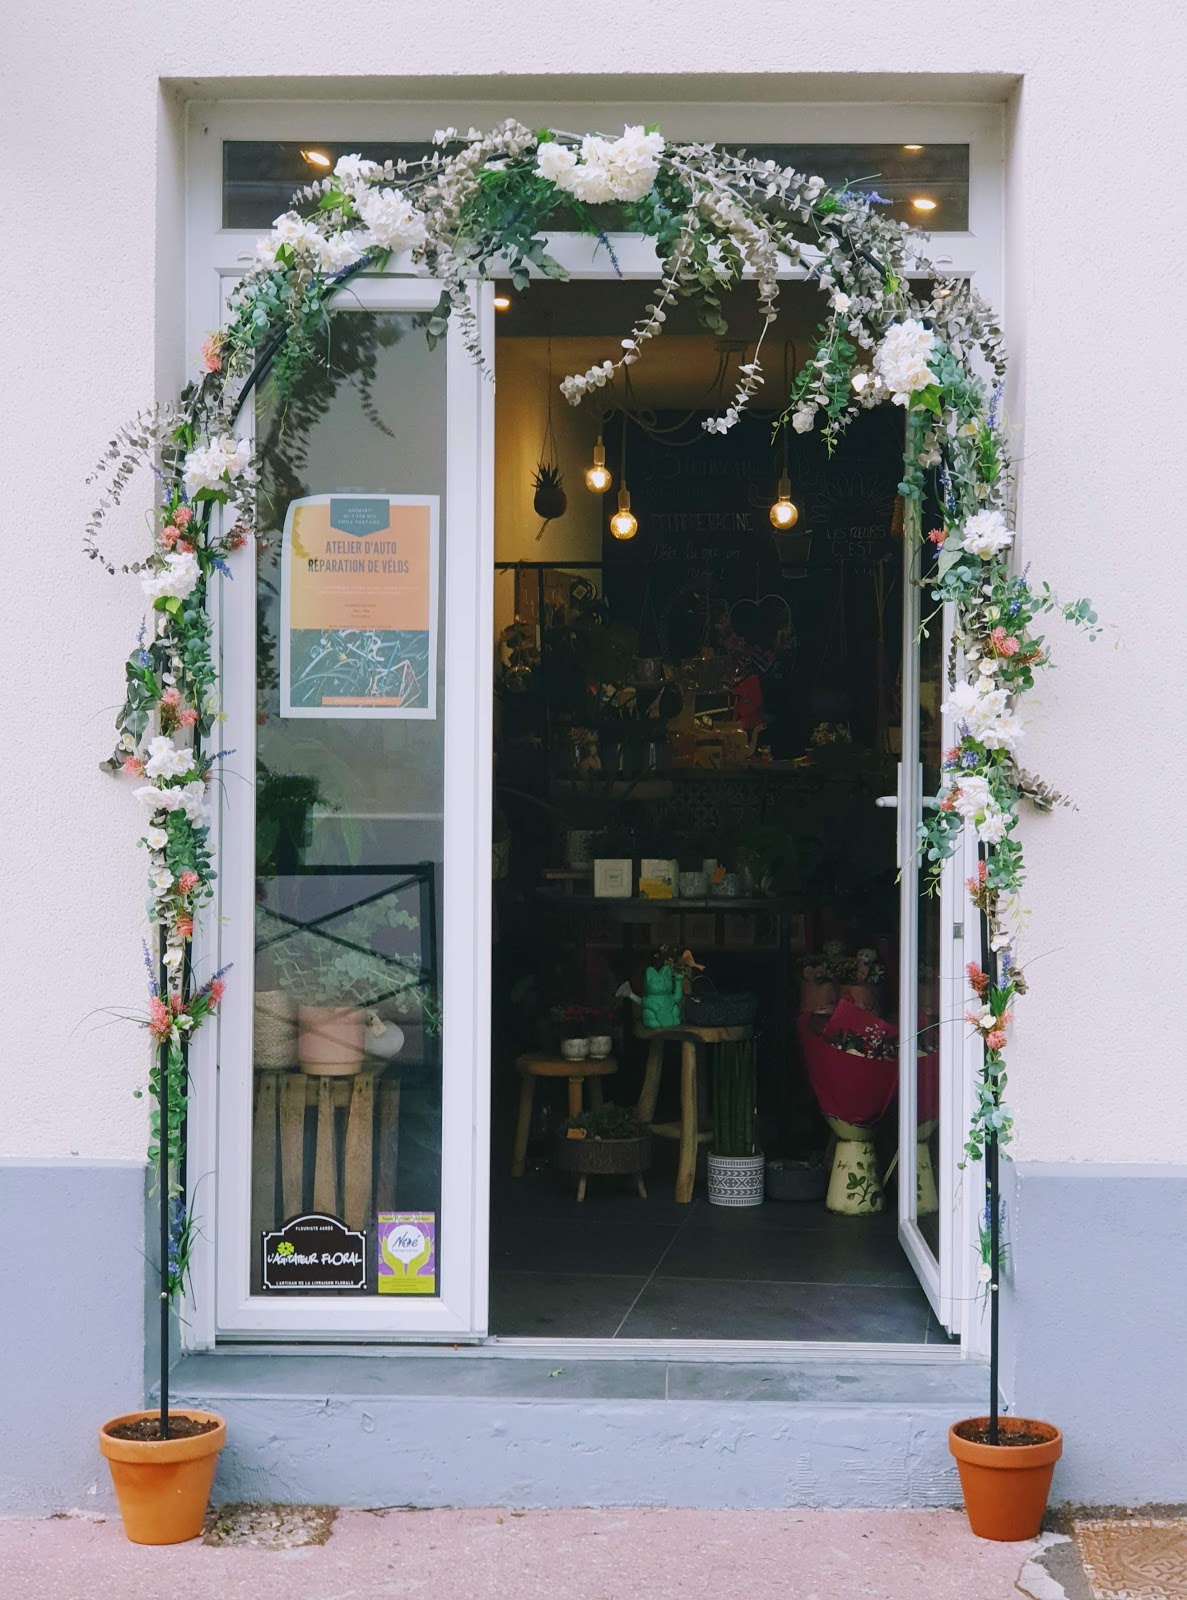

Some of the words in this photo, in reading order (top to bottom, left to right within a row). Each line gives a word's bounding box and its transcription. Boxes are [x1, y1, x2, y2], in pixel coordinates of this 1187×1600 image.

[325, 540, 362, 555] ATELIER
[364, 541, 397, 555] D'AUTO
[308, 557, 365, 573] RÉPARATION
[367, 560, 379, 573] DE
[381, 558, 409, 573] VÉLOS
[392, 1231, 421, 1248] Noé
[267, 1252, 319, 1266] L'AGITATEUR
[321, 1251, 363, 1267] FLORAL
